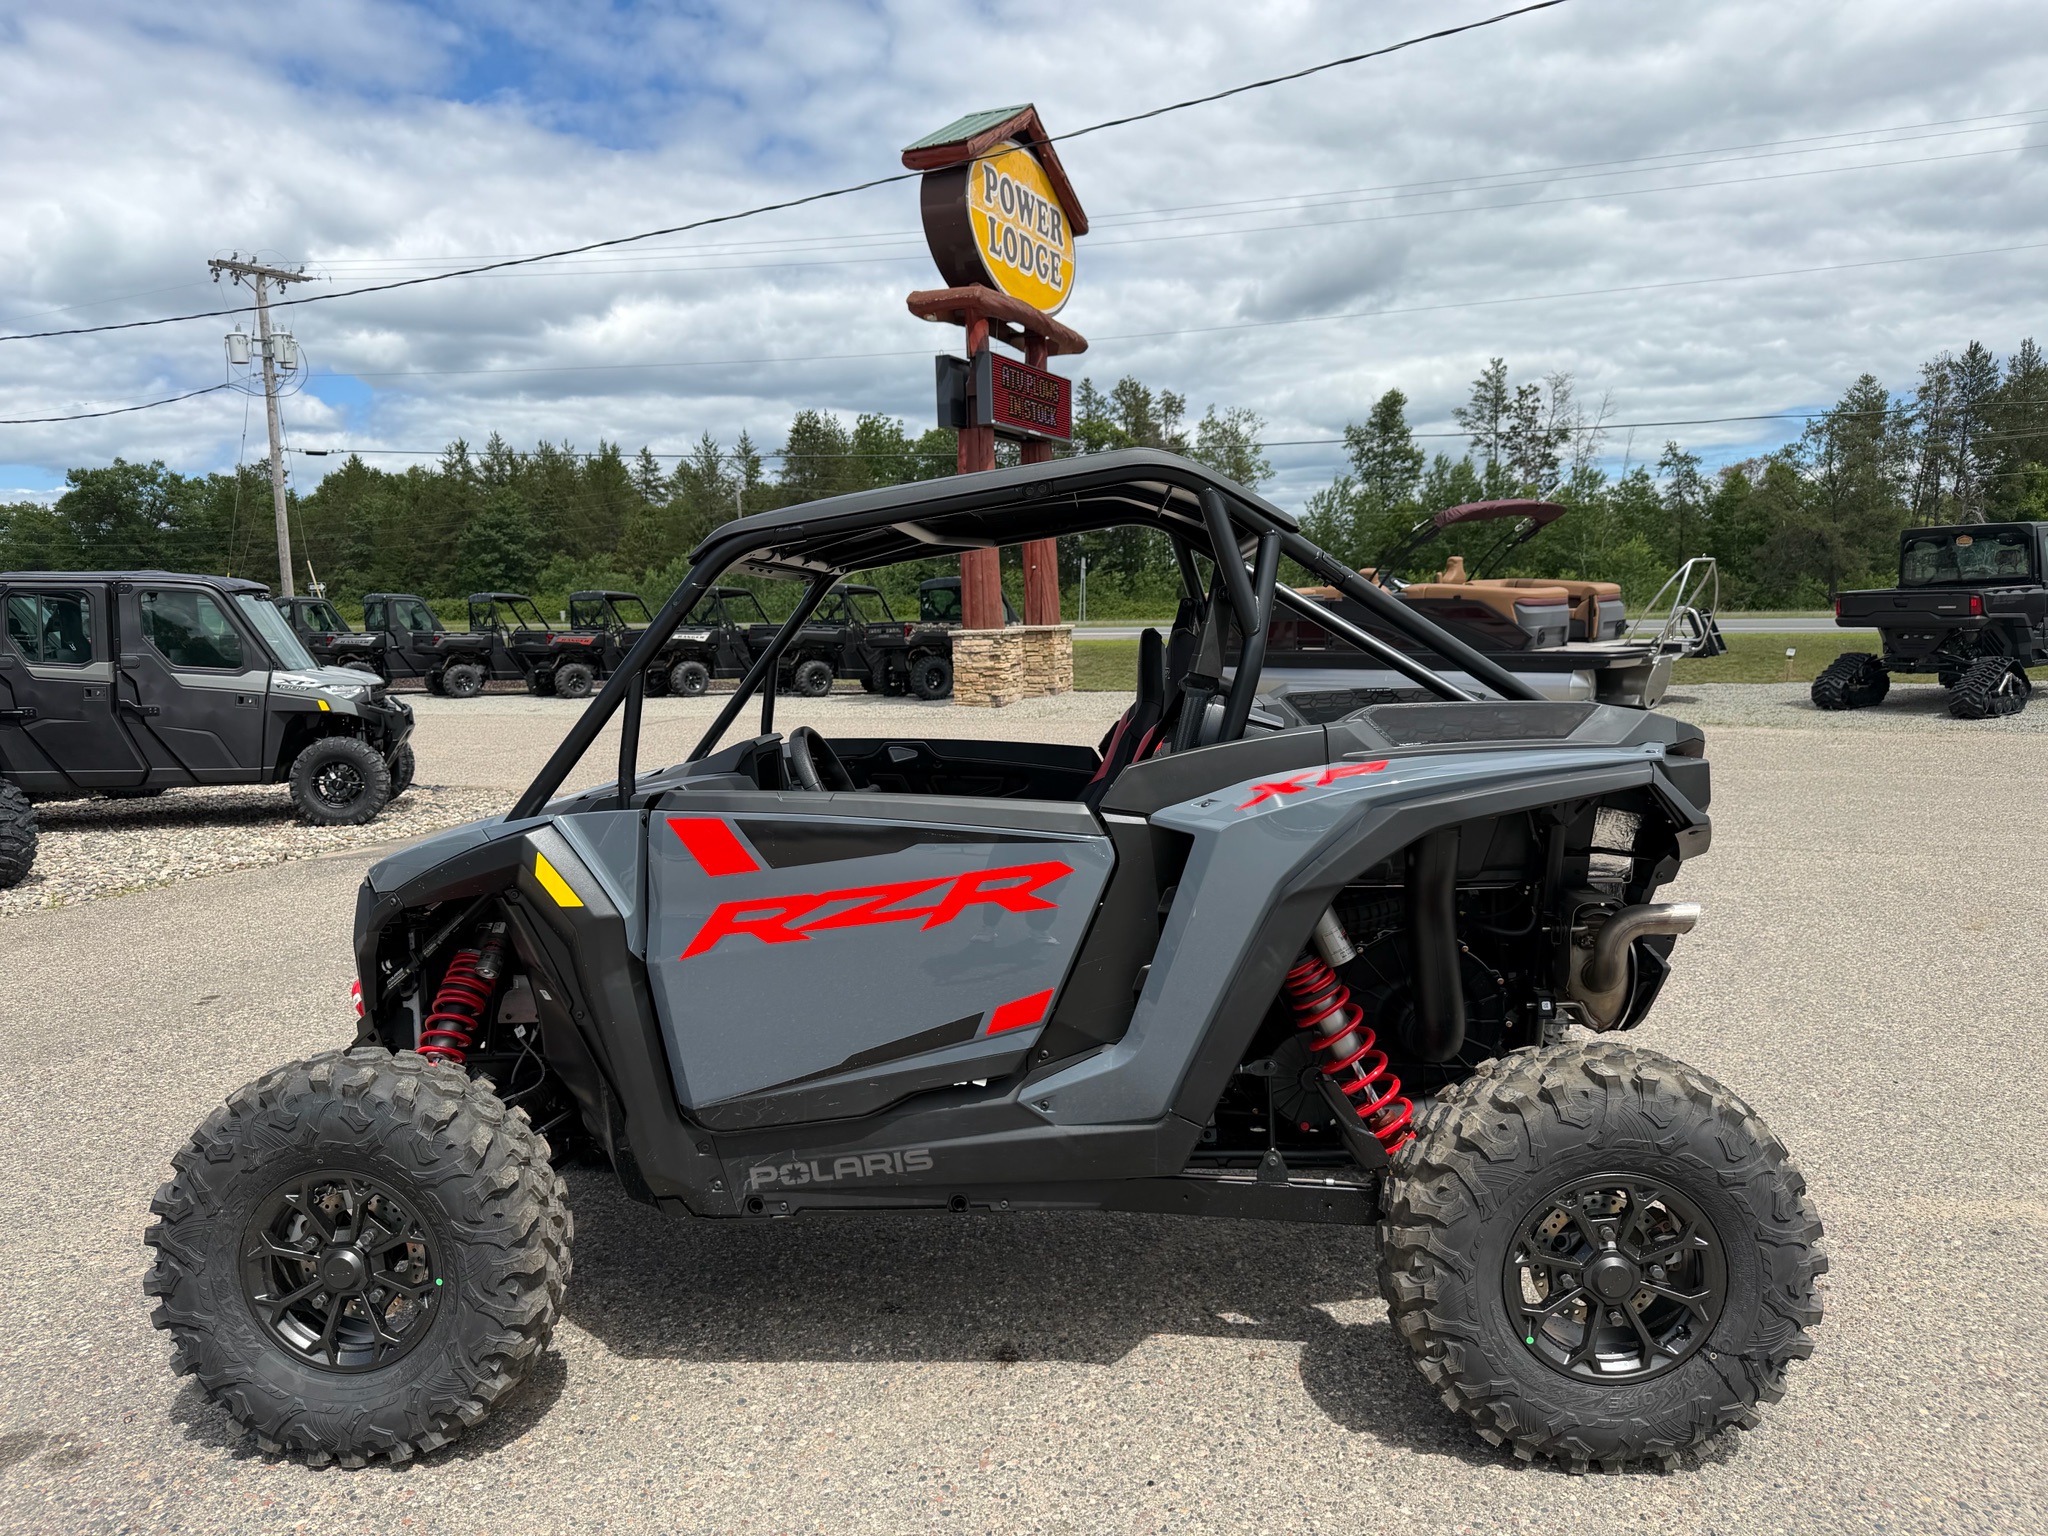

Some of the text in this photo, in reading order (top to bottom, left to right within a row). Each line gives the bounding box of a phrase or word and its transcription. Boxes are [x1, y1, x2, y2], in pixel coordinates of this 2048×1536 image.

[982, 163, 1064, 248] POWER
[987, 214, 1063, 289] LODGE
[1002, 366, 1060, 402] ATV PLOWS
[1008, 395, 1057, 426] IN STOCK
[1234, 759, 1390, 812] XP
[679, 860, 1076, 961] RZR
[748, 1147, 934, 1190] POLARIS
